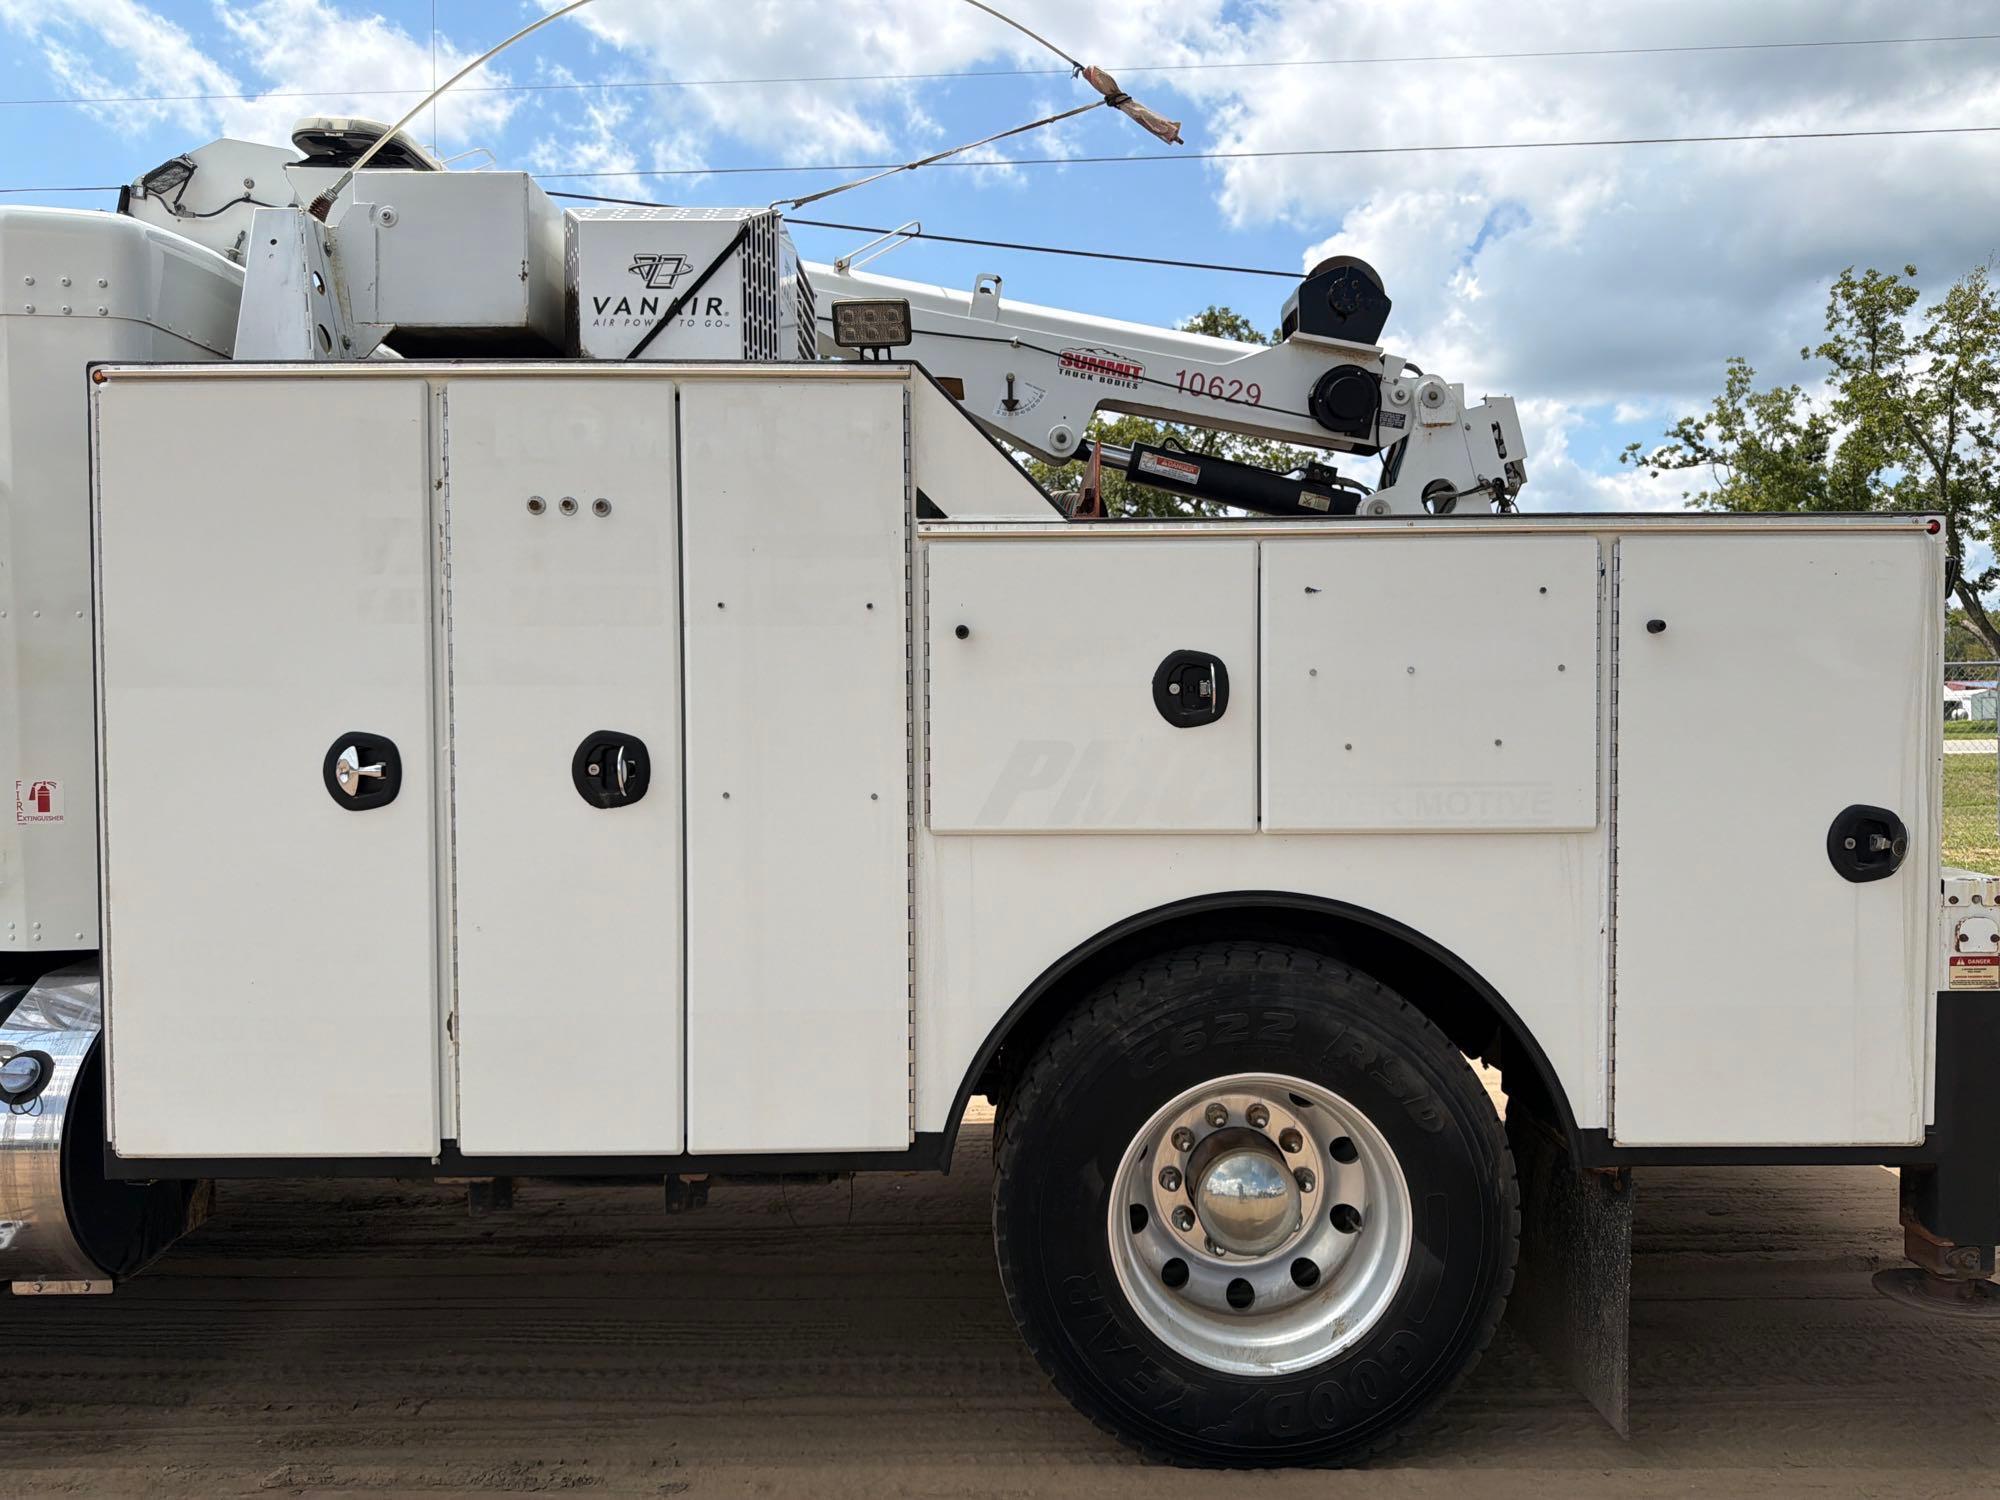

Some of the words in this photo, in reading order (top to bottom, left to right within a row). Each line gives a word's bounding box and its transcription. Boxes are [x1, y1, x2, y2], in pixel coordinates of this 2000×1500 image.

[680, 319, 695, 327] TO
[1060, 352, 1143, 380] SUMMIT
[1059, 368, 1093, 381] TRUCK
[1099, 376, 1138, 390] BODIES
[1176, 370, 1261, 406] 10629
[1414, 789, 1553, 817] MOTIVE
[1967, 958, 1991, 966] DANGER
